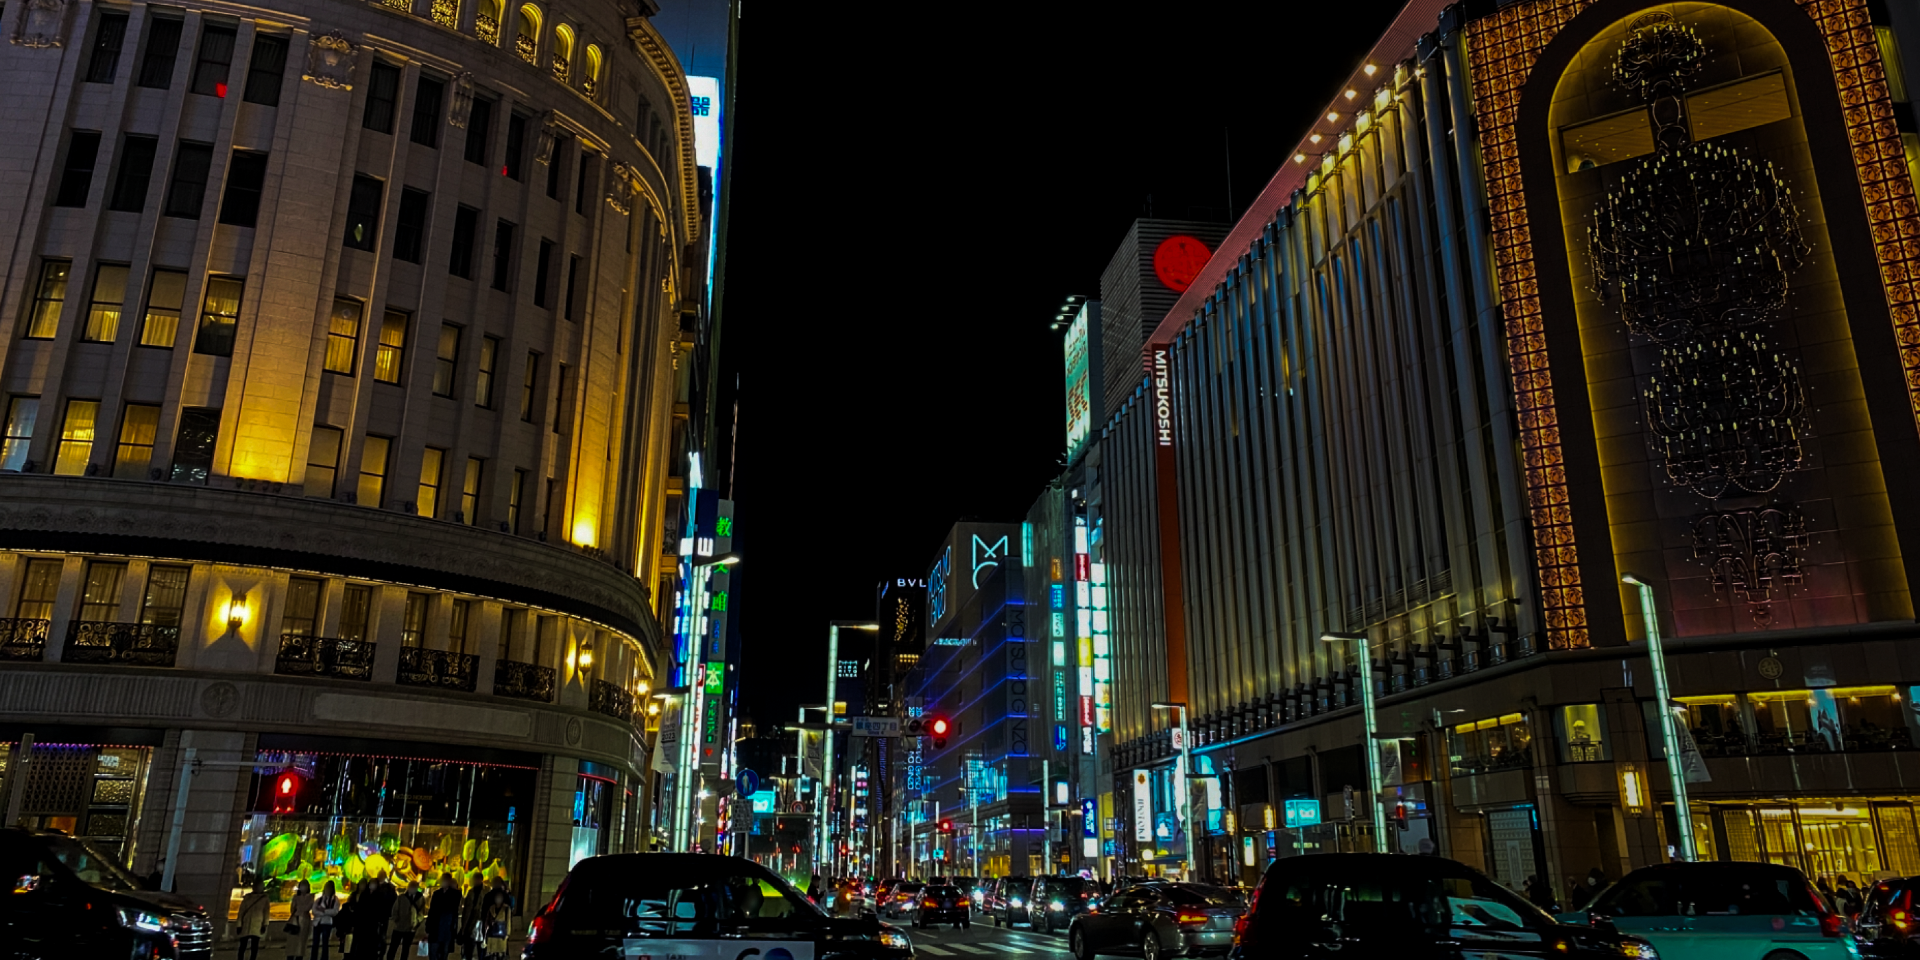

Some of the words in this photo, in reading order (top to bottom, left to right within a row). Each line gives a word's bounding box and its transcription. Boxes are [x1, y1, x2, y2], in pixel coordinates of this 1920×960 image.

[1155, 350, 1172, 446] MITSUKOSHI
[706, 667, 722, 689] 本
[662, 733, 676, 741] 2023
